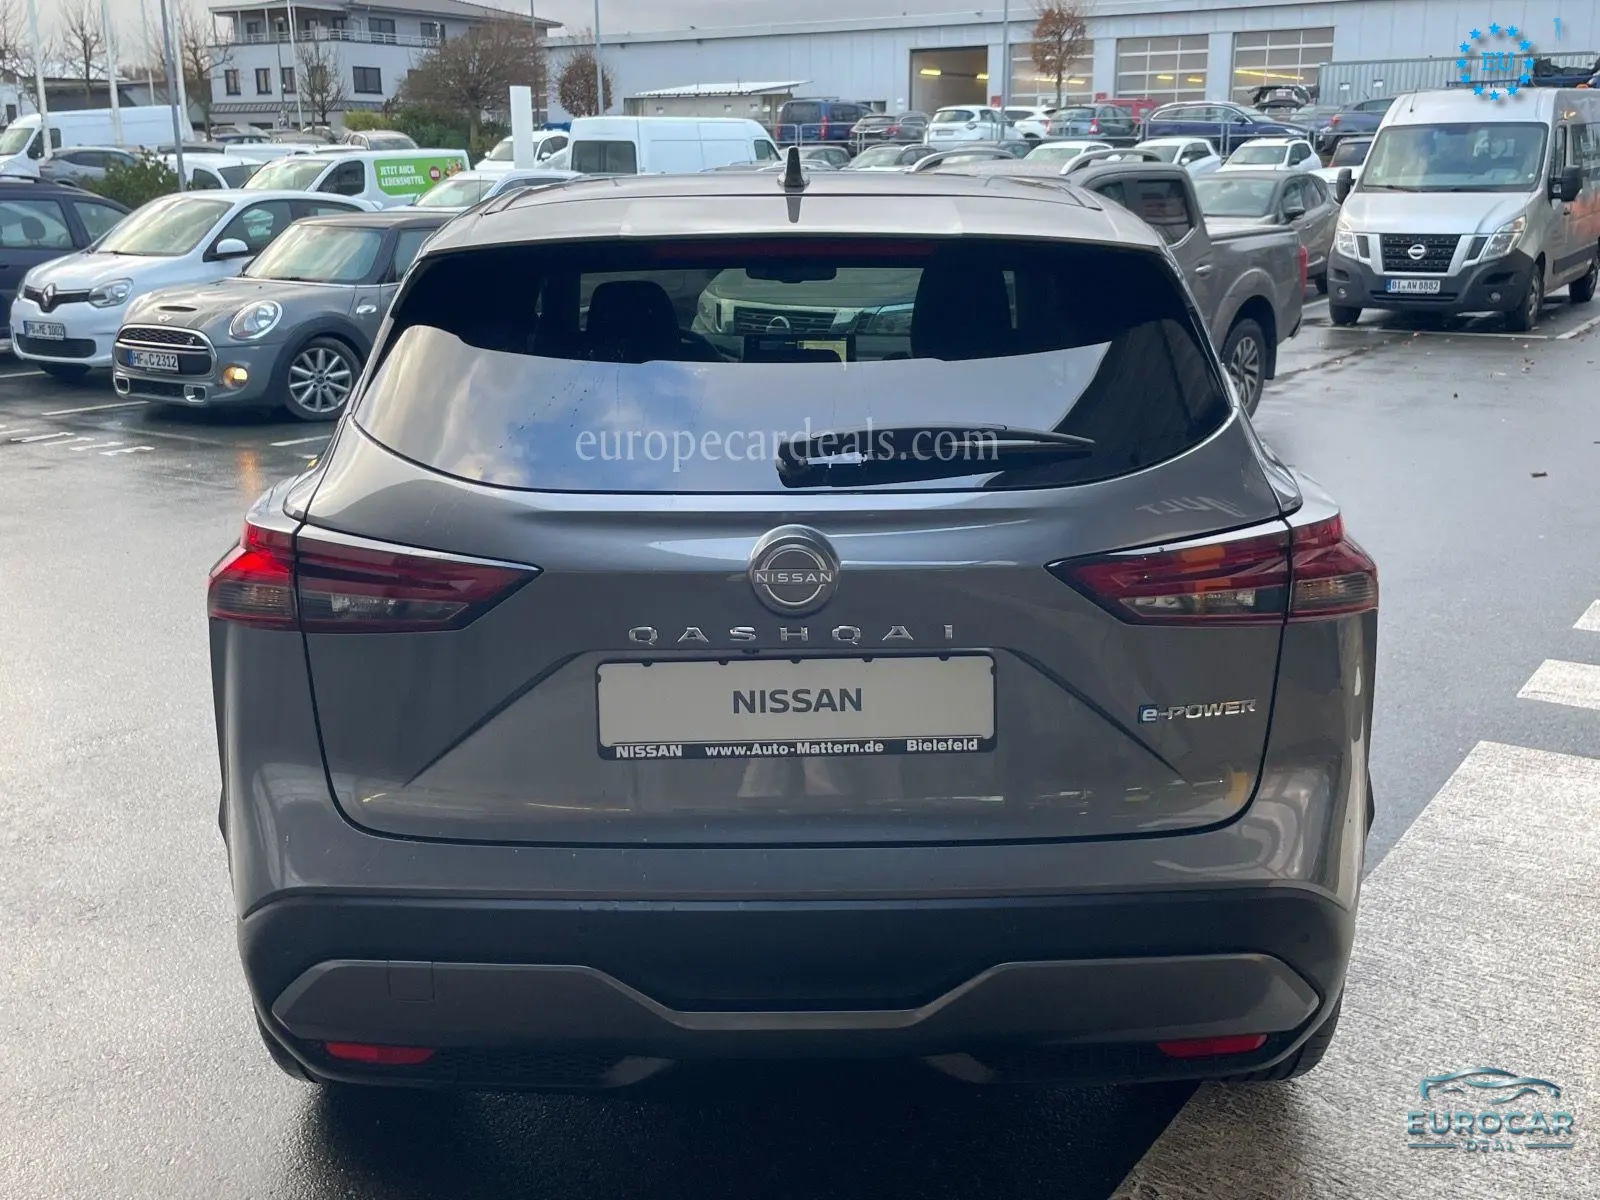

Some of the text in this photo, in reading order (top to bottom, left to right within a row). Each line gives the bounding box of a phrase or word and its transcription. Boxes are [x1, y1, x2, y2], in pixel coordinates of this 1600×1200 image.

[380, 165, 398, 176] JETZT
[398, 164, 416, 175] AUCH
[381, 175, 425, 187] LEBENSMITTEL
[155, 354, 178, 368] 2312
[755, 571, 832, 584] NISSAN
[628, 624, 954, 645] QASHQAI
[732, 687, 862, 714] NISSAN
[1138, 698, 1256, 723] e-POWER
[615, 737, 979, 759] NISSAN www.Auto-Mattern.de Bielefeld
